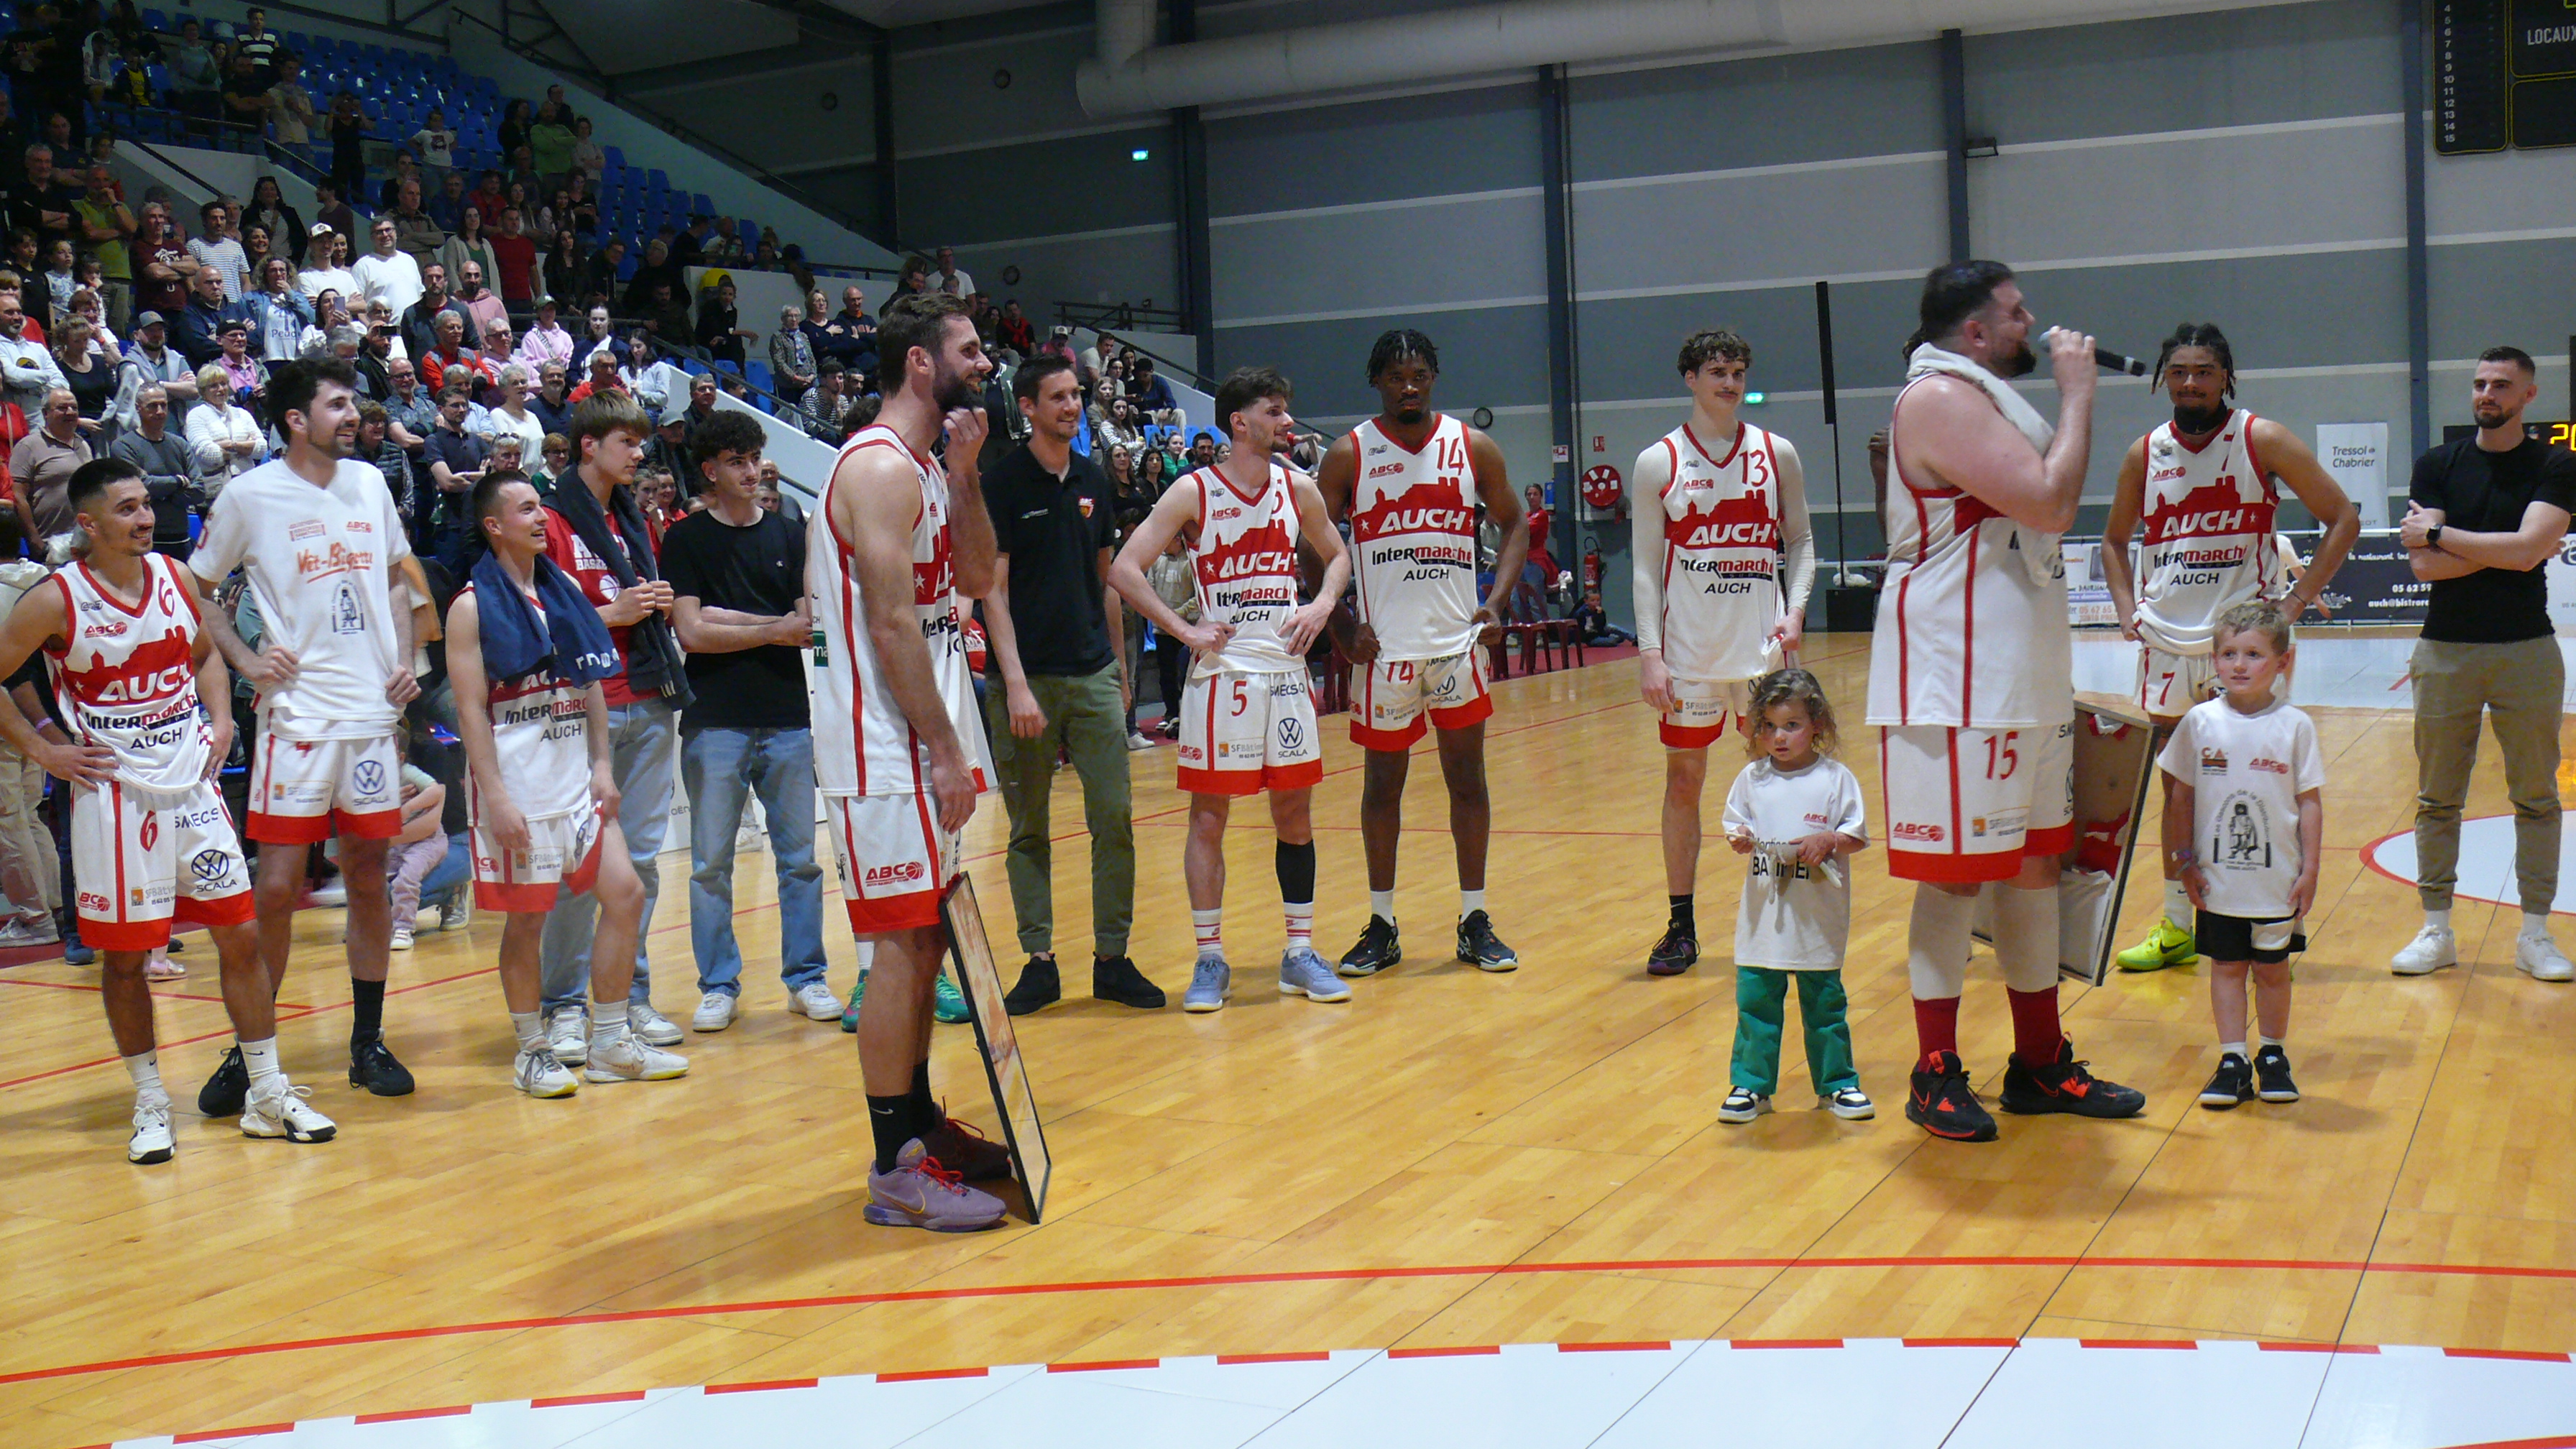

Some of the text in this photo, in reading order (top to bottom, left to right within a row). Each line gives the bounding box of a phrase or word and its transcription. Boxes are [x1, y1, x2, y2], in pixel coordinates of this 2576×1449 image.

[1435, 437, 1464, 476] 14
[2332, 446, 2367, 456] Tressol
[1369, 464, 1394, 474] ABC
[1739, 449, 1768, 487] 13
[2332, 458, 2375, 468] Chabrier
[1378, 508, 1466, 534] AUCH
[2161, 509, 2244, 538] AUCH
[1685, 523, 1772, 546] AUCH
[575, 558, 607, 571] BASK
[1220, 552, 1291, 579] AUCH
[1403, 569, 1449, 581] AUCH
[2170, 573, 2220, 586] AUCH
[158, 576, 175, 617] 6
[1705, 583, 1751, 594] AUCH
[2392, 583, 2432, 593] 05 62 59
[85, 622, 116, 635] ABC
[2159, 671, 2176, 707] 7
[1231, 680, 1247, 717] 5
[131, 727, 182, 749] AUCH
[540, 724, 581, 742] AUCH
[1278, 749, 1308, 758] SCALA
[1984, 731, 2019, 781] 15
[353, 796, 391, 806] SCALA
[140, 810, 157, 852] 6
[1893, 822, 1929, 835] ABC
[865, 862, 906, 880] ABC
[196, 879, 238, 893] SCALA
